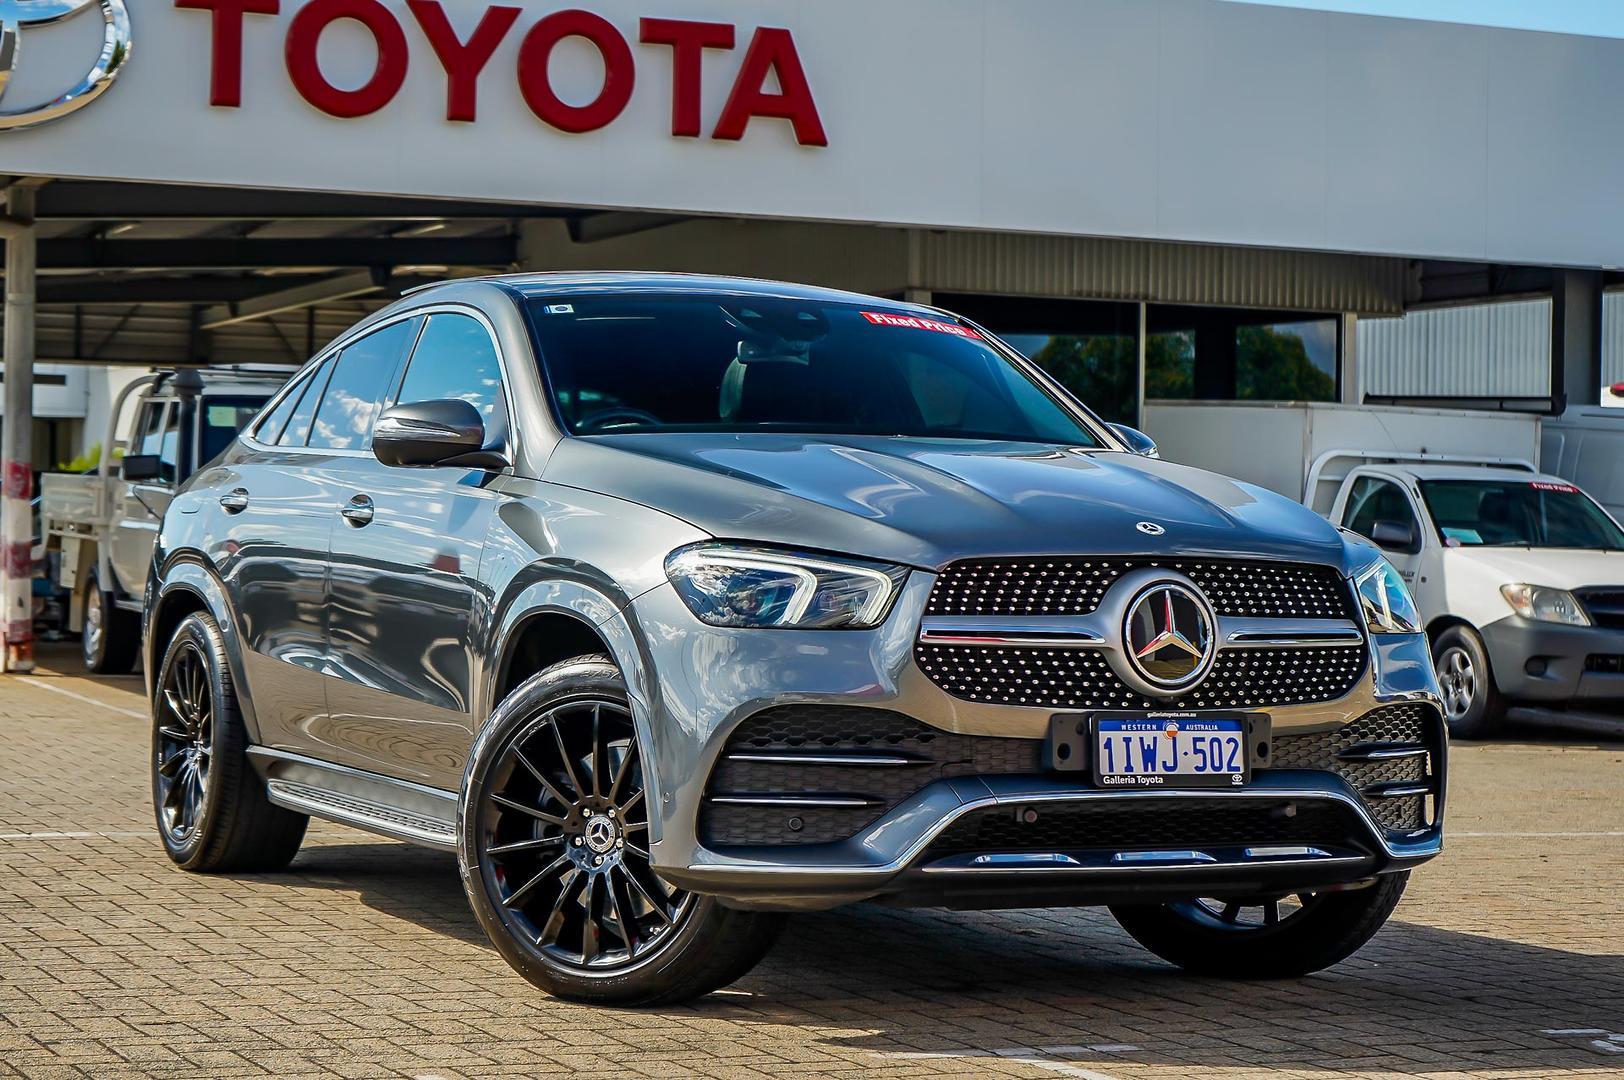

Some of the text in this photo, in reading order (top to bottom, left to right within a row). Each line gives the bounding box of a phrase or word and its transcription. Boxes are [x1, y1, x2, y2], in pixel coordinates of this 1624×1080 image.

[174, 0, 829, 148] TOYOTA
[869, 313, 967, 336] Fixed Price
[1103, 775, 1164, 785] Galleria Toyota
